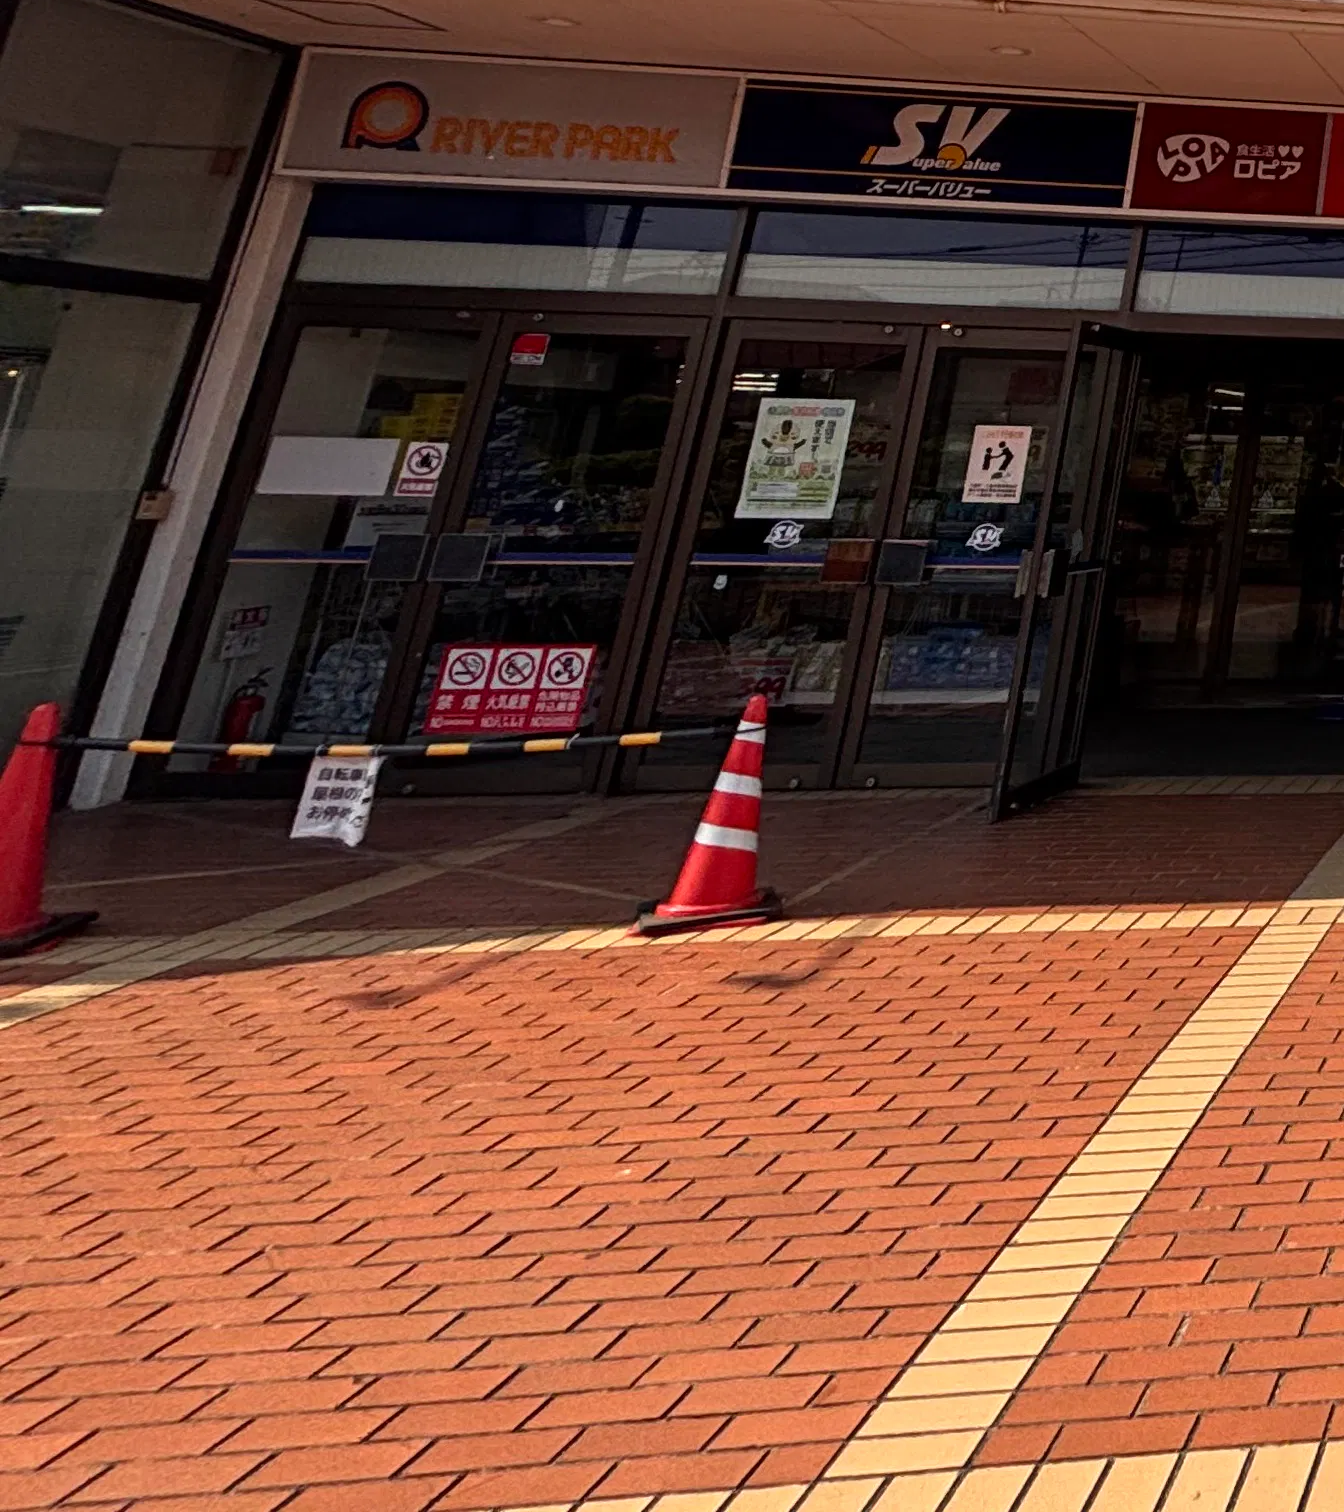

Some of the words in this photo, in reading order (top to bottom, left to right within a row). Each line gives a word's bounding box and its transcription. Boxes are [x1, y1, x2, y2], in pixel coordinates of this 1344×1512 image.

[430, 116, 560, 160] RIVER
[564, 122, 680, 164] PARK
[1236, 144, 1275, 157] 食生活
[1233, 160, 1302, 181] ロピア
[865, 178, 992, 198] スーパーバリュー
